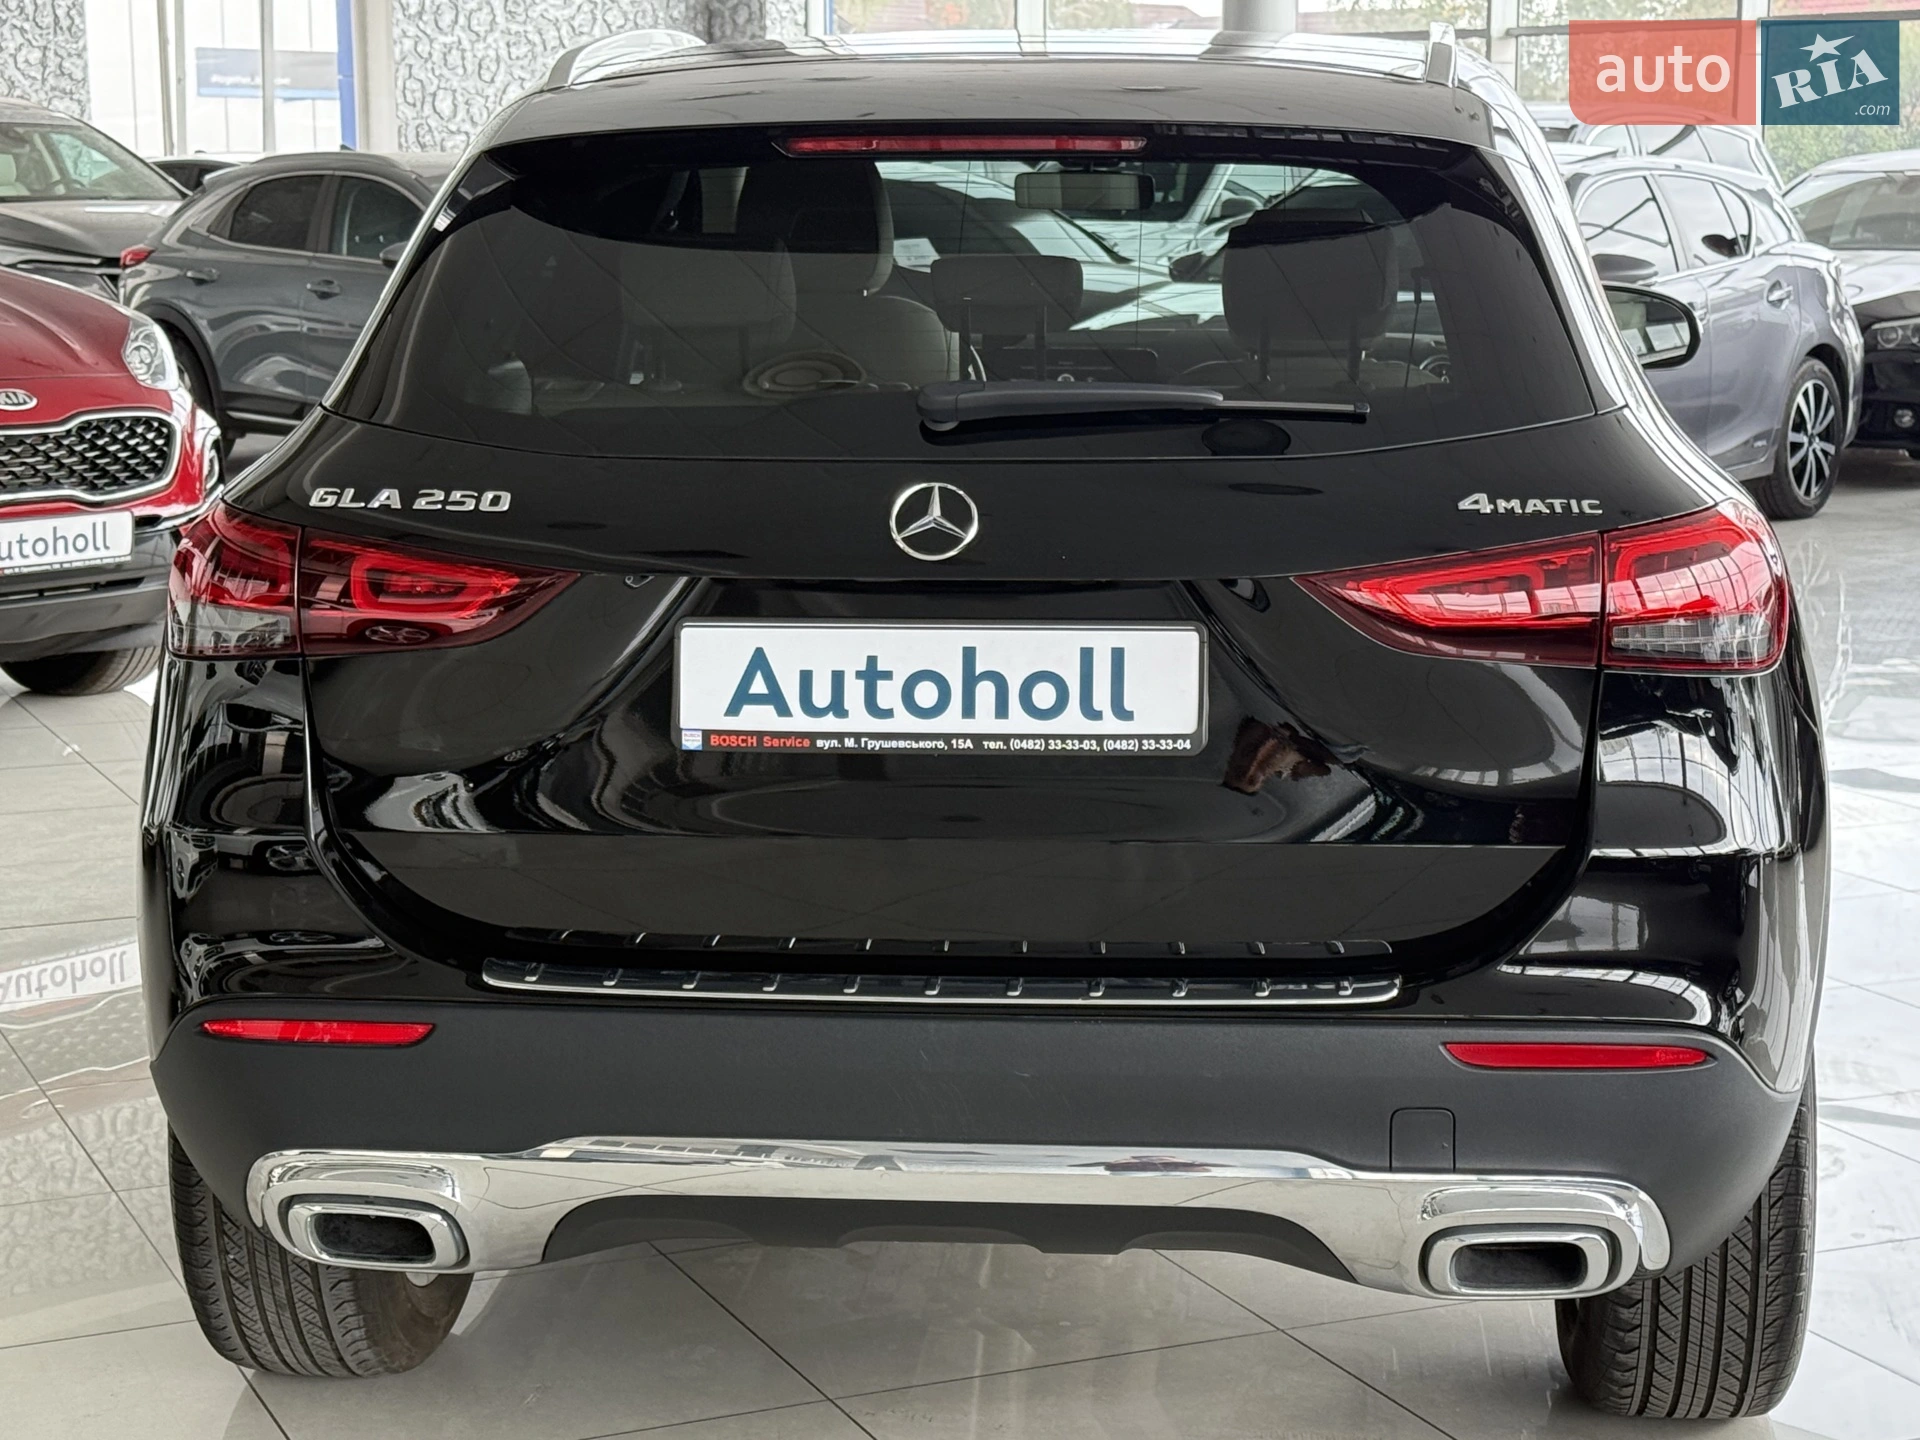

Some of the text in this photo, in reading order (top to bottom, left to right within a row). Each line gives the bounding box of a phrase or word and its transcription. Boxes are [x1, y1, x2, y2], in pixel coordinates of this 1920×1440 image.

[309, 488, 511, 512] GLA 250
[1457, 493, 1603, 514] 4MATIC
[0, 521, 111, 561] utoholl
[723, 646, 1135, 722] Autoholl
[710, 734, 757, 748] BOSCH
[763, 735, 811, 748] Service
[816, 738, 842, 750] вул.
[861, 737, 948, 750] Грушевського,
[982, 740, 1007, 750] тел.
[1010, 738, 1045, 751] (0482)
[1048, 739, 1100, 752] 33-33-03,
[1103, 738, 1139, 752] (0482)
[1142, 739, 1191, 751] 33-33-04
